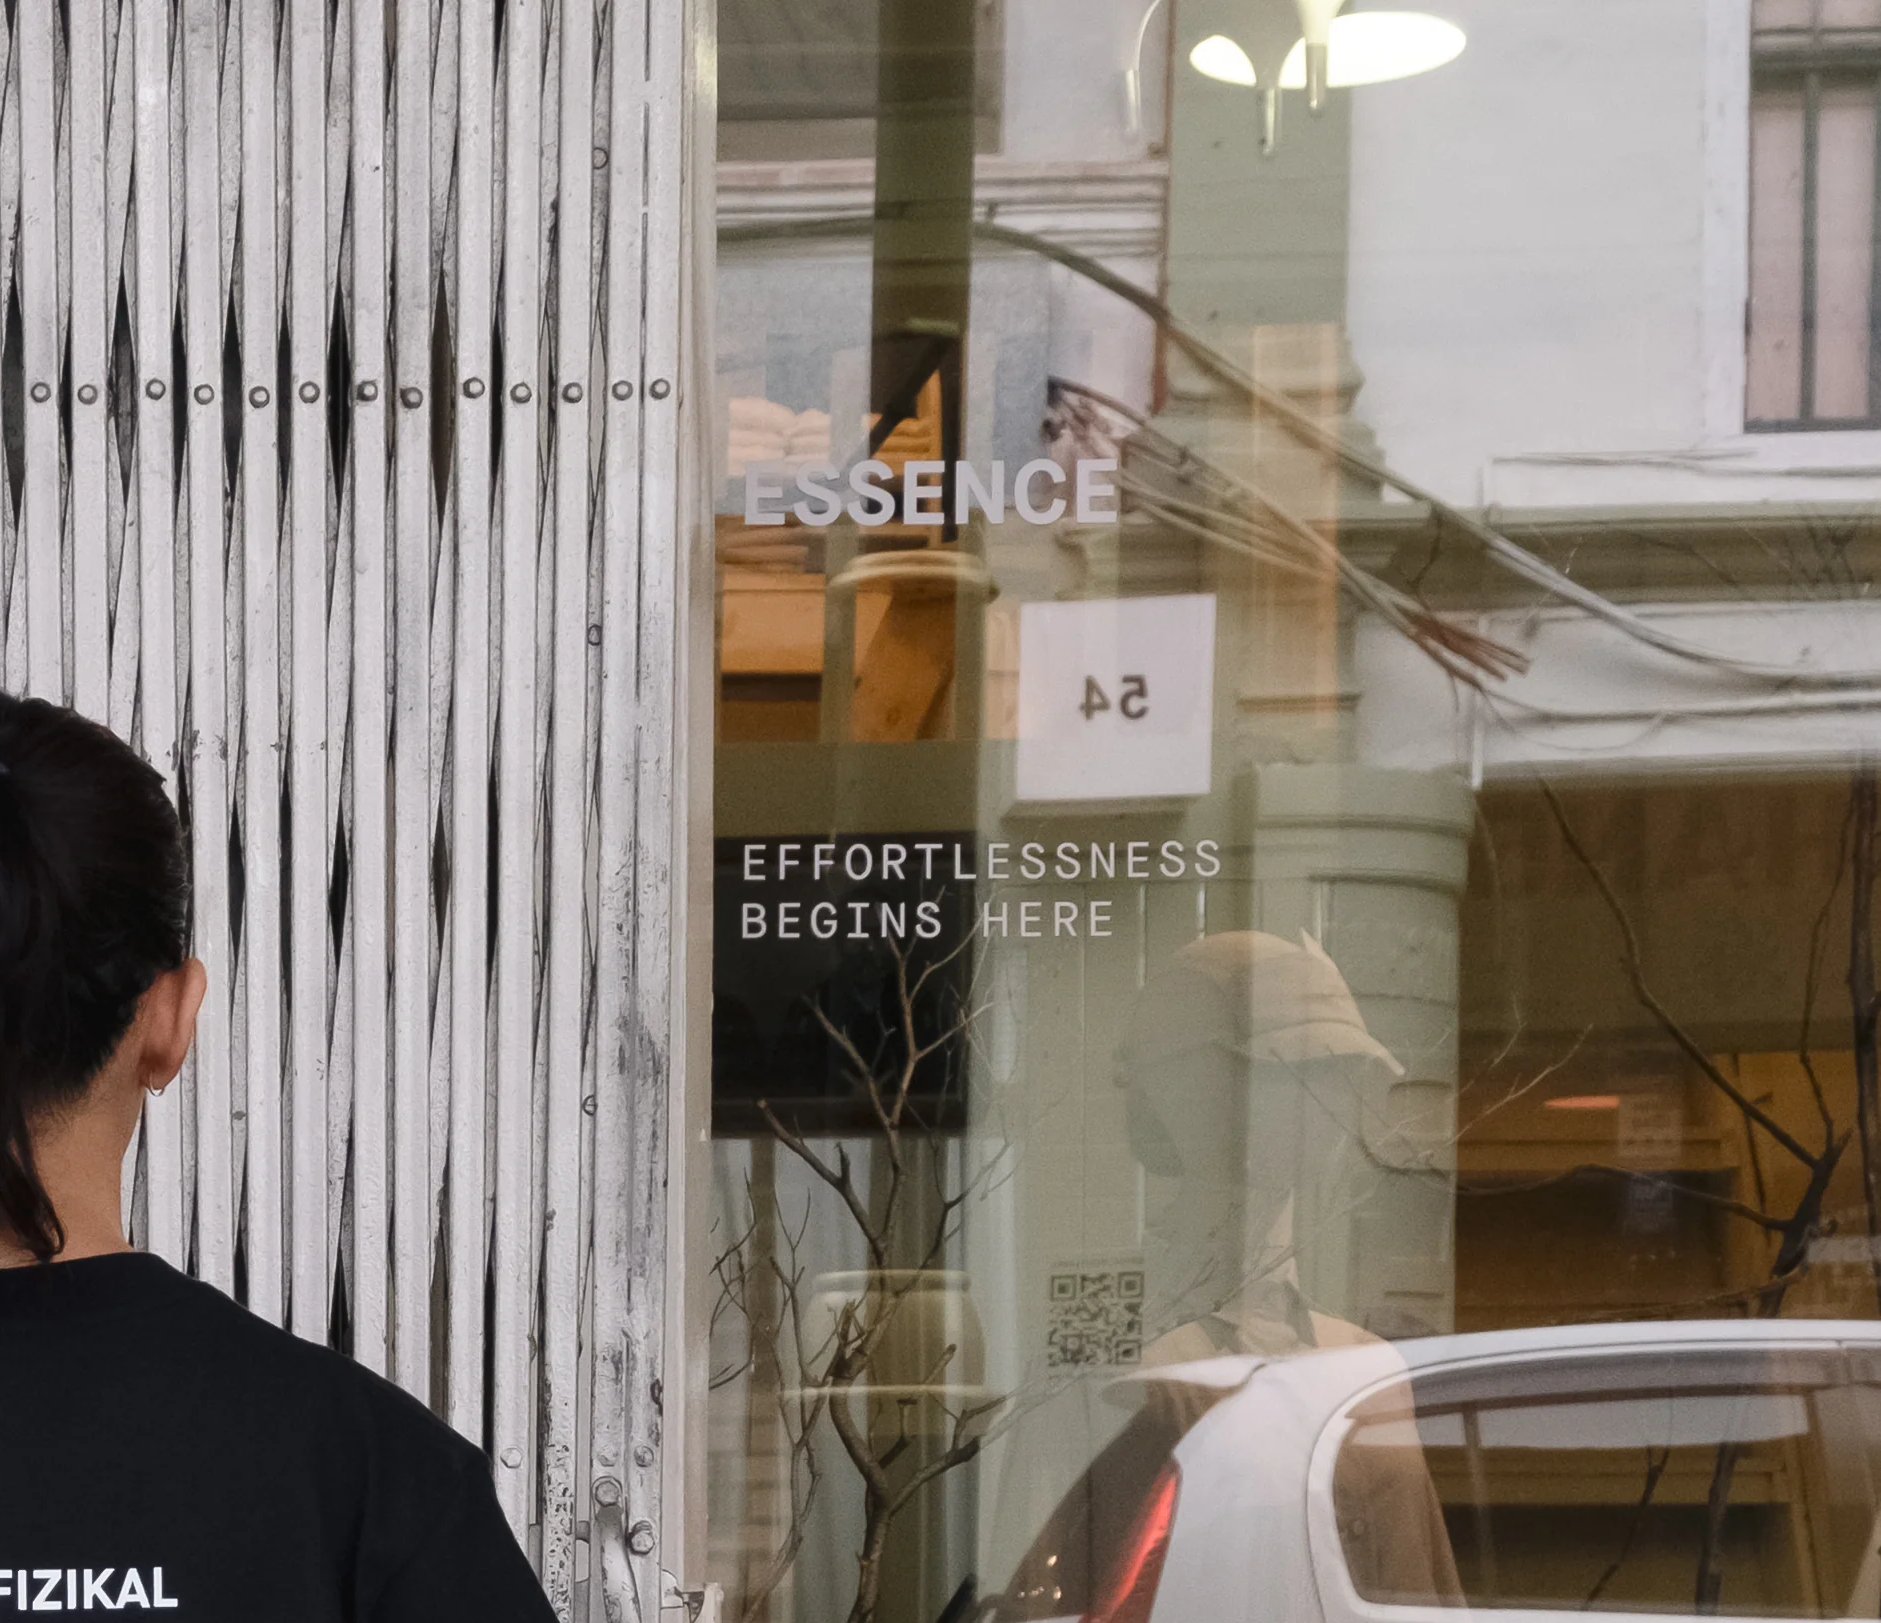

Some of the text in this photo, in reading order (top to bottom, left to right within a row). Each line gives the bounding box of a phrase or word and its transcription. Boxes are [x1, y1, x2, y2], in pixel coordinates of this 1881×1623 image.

[744, 458, 1118, 526] ESSENCE
[743, 839, 1221, 881] EFFORTLESSNESS
[741, 900, 1114, 940] BEGINS HERE
